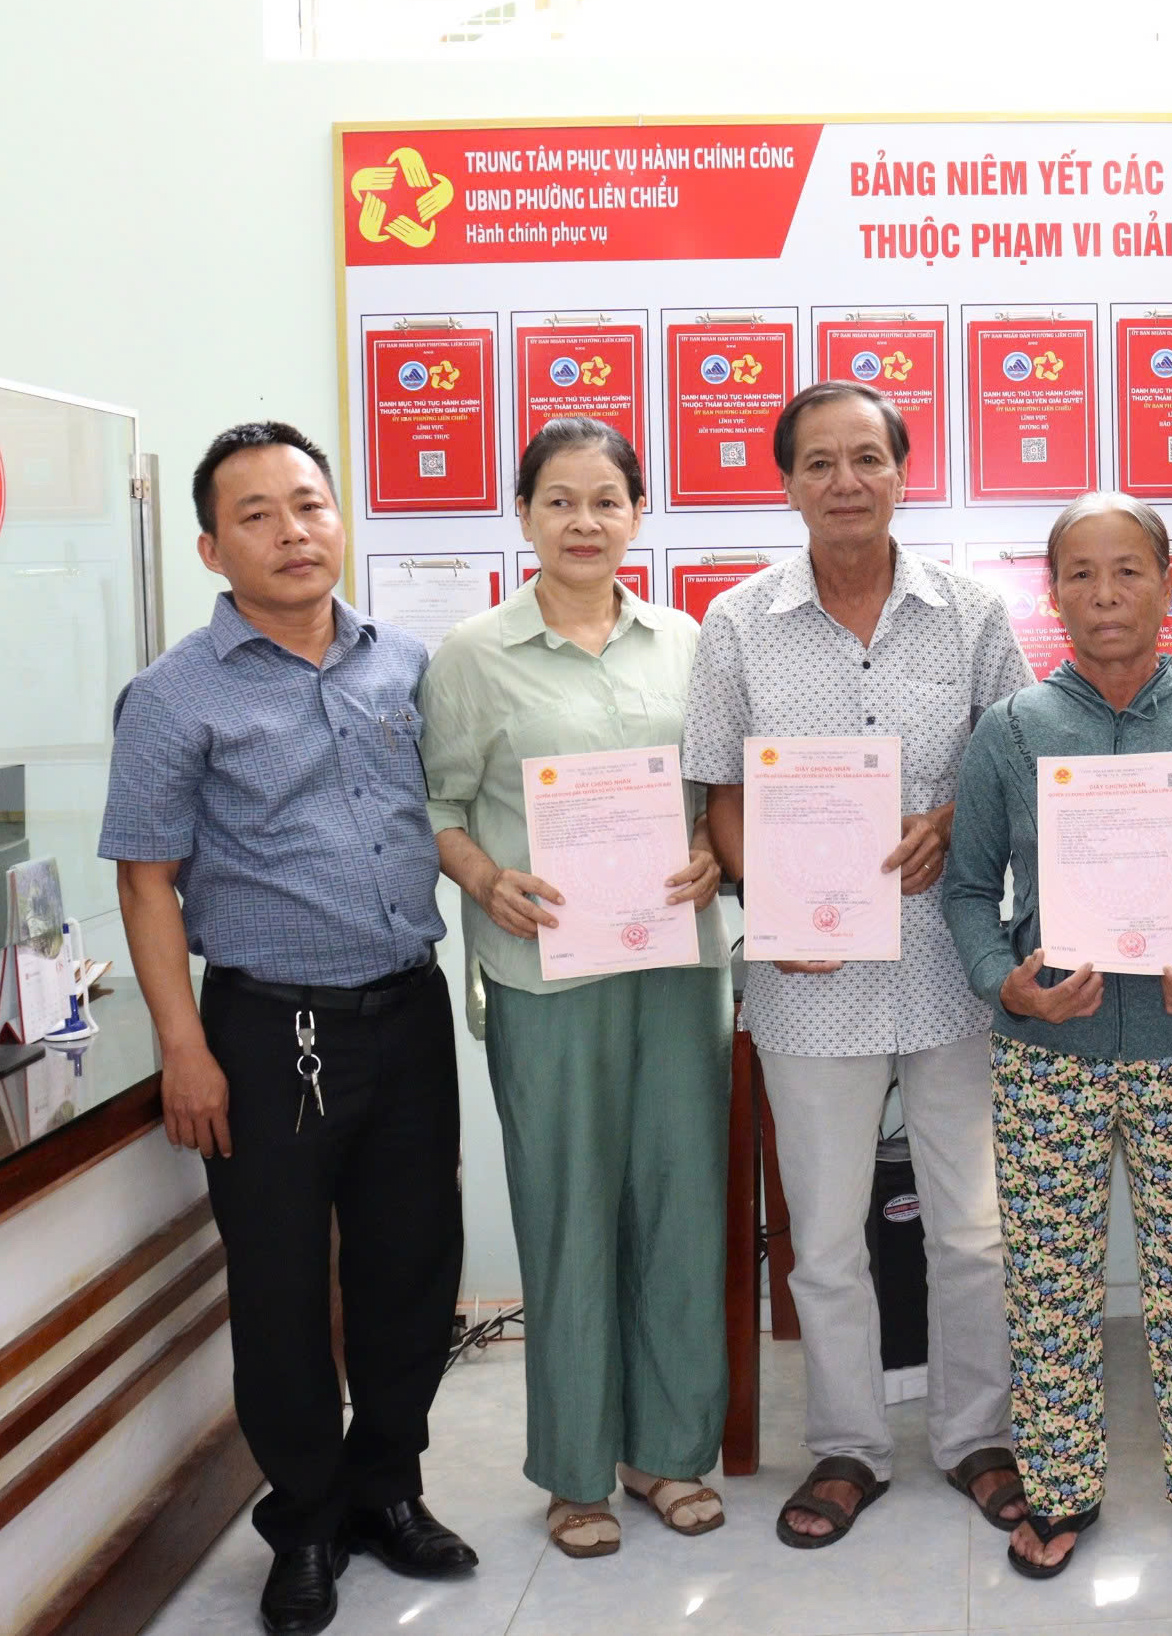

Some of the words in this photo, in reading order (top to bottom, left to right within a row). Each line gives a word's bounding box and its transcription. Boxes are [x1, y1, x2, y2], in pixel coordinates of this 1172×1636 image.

[465, 150, 522, 173] TRUNG
[527, 145, 562, 172] TÂM
[567, 148, 611, 176] PHỤC
[615, 148, 637, 175] VỤ
[642, 143, 689, 170] HÀNH
[694, 142, 744, 170] CHÍNH
[750, 142, 794, 168] CÔNG
[850, 150, 935, 196] BẢNG
[947, 153, 1027, 195] NIÊM
[1038, 149, 1092, 195] YẾT
[1103, 153, 1163, 195] CÁC
[465, 188, 511, 212] UBND
[516, 184, 585, 210] PHƯỜNG
[590, 182, 626, 209] LIÊN
[630, 175, 678, 207] CHIỂU
[466, 223, 504, 243] Hành
[509, 223, 546, 241] chính
[551, 222, 587, 247] phục
[590, 227, 607, 245] vụ
[860, 216, 959, 266] THUỘC
[972, 223, 1061, 265] PHẠM
[1073, 223, 1100, 256] VI
[1112, 211, 1172, 257] GIẢI
